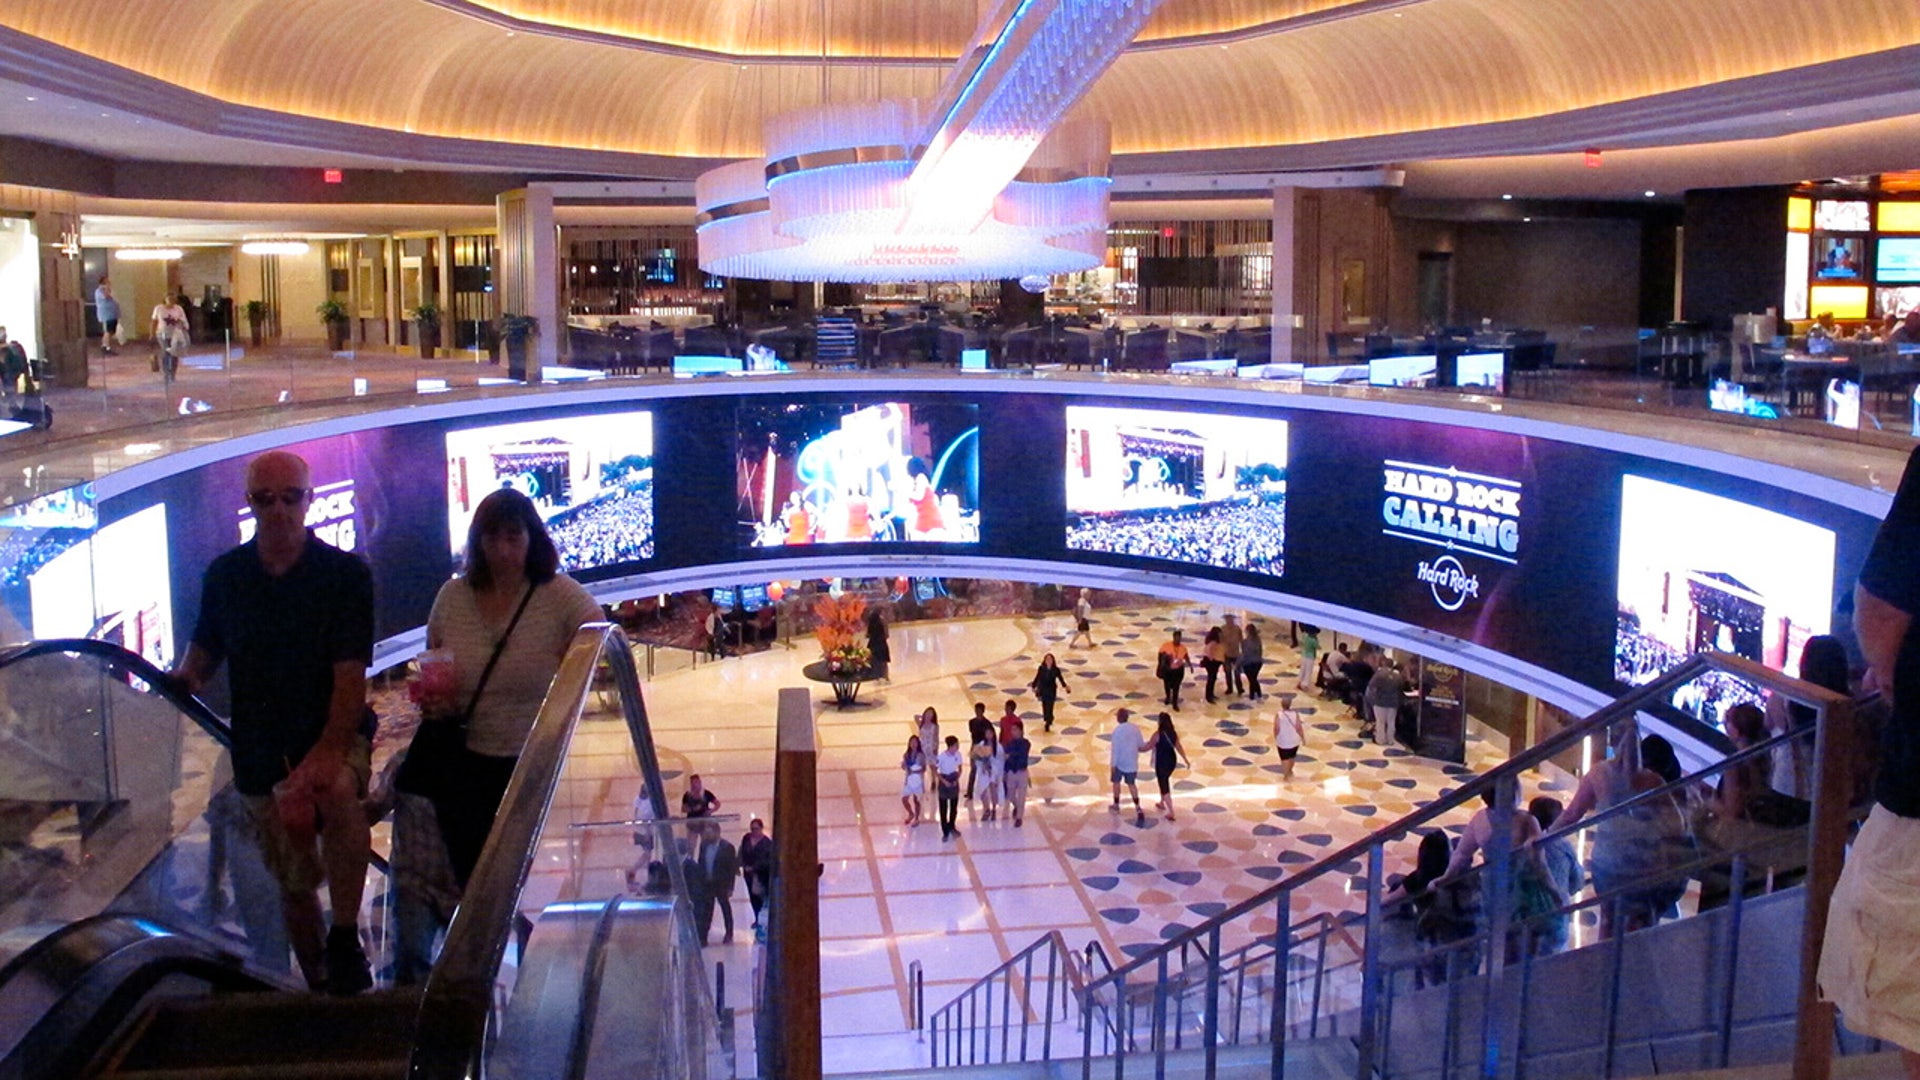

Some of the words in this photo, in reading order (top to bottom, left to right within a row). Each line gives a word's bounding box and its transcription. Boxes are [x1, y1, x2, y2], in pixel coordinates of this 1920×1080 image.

[1384, 469, 1453, 502] HARD
[1455, 481, 1521, 517] ROCK
[1383, 496, 1519, 553] CALLING
[1417, 561, 1450, 586] Hard
[1449, 569, 1479, 598] Rock
